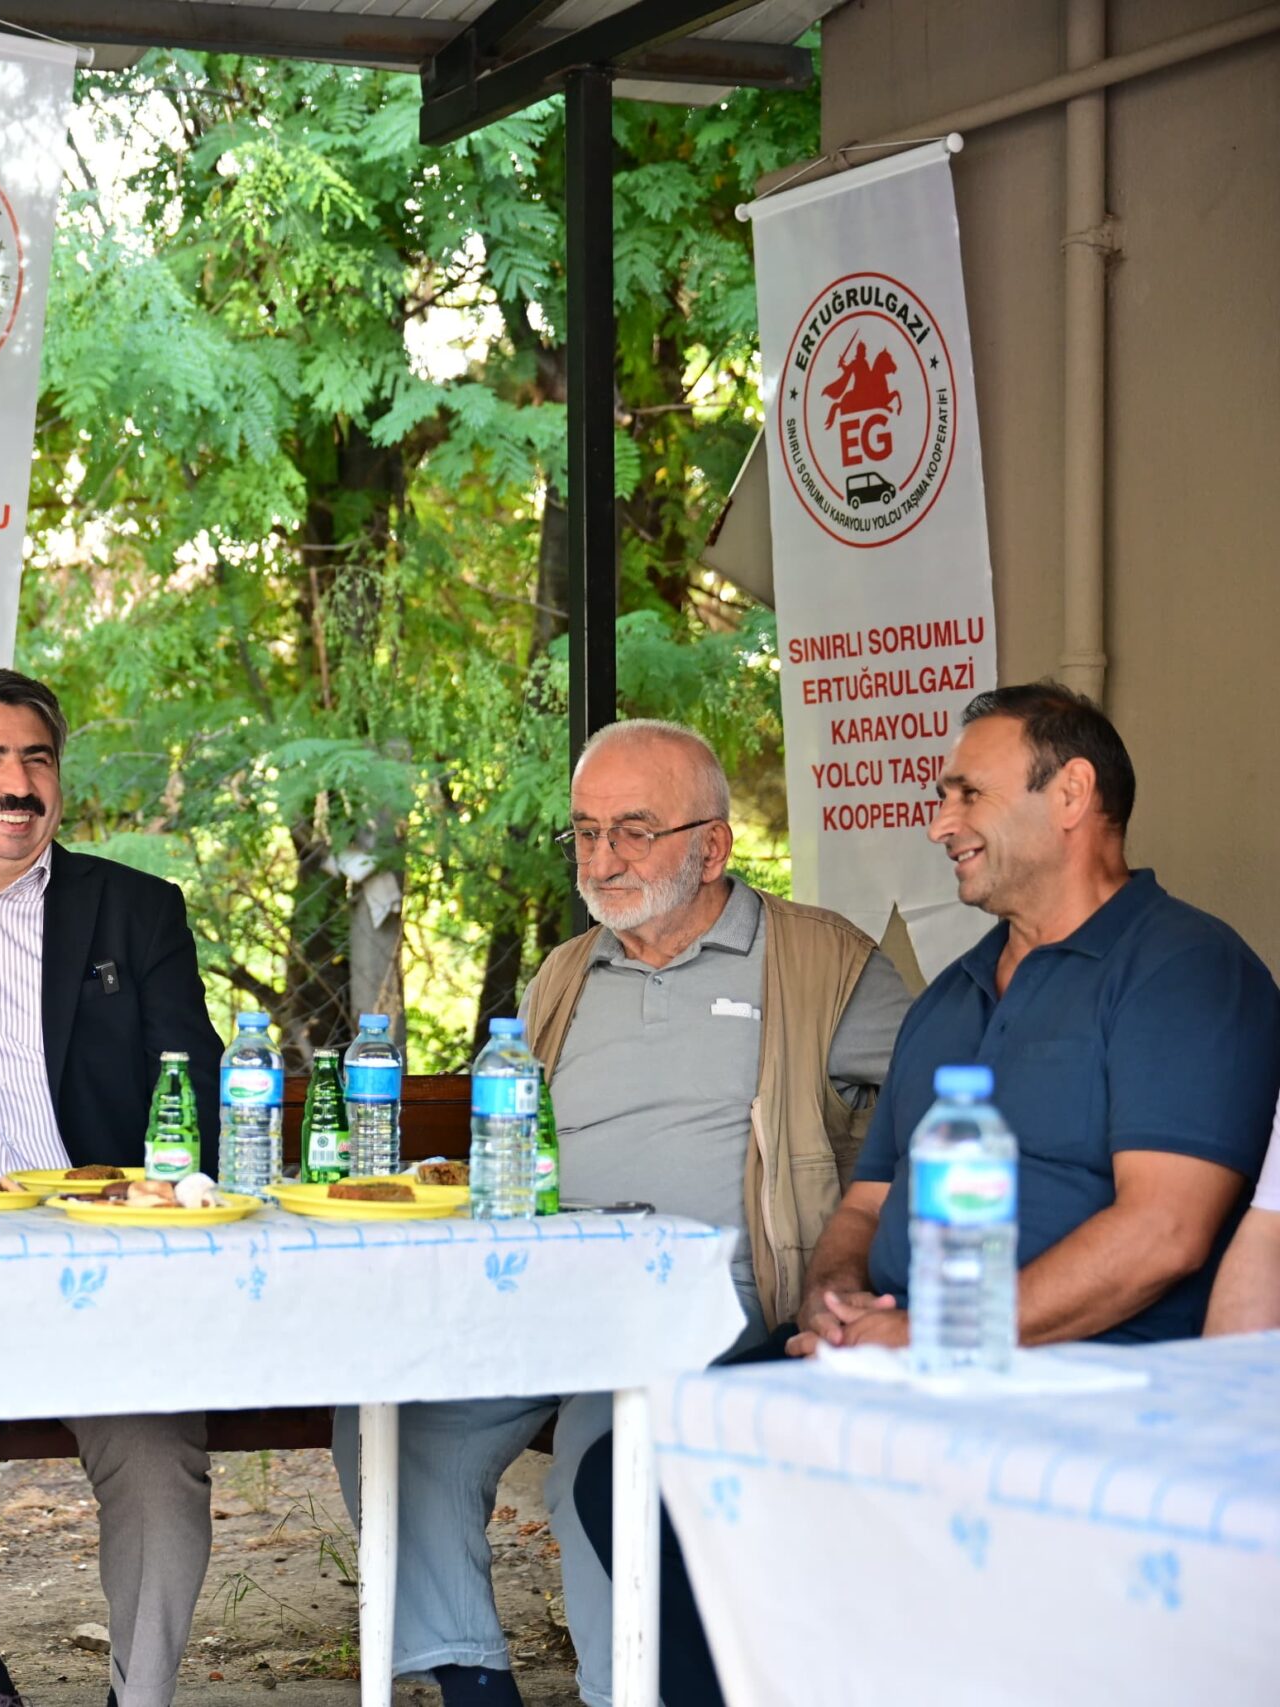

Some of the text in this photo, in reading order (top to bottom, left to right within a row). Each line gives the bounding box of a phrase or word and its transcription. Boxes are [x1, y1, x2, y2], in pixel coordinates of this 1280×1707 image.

[795, 286, 931, 372] ERTUĞRULGAZİ
[786, 388, 948, 532] SINIRLI SORUMLU KARAYOLU YOLCU TAŞIMA KOOPERATİFİ
[839, 413, 892, 467] EG
[788, 616, 984, 664] SINIRLI SORUMLU
[803, 656, 975, 705] ERTUĞRULGAZİ
[831, 711, 948, 745] KARAYOLU
[812, 760, 883, 789] YOLCU
[822, 800, 943, 831] KOOPERAT
